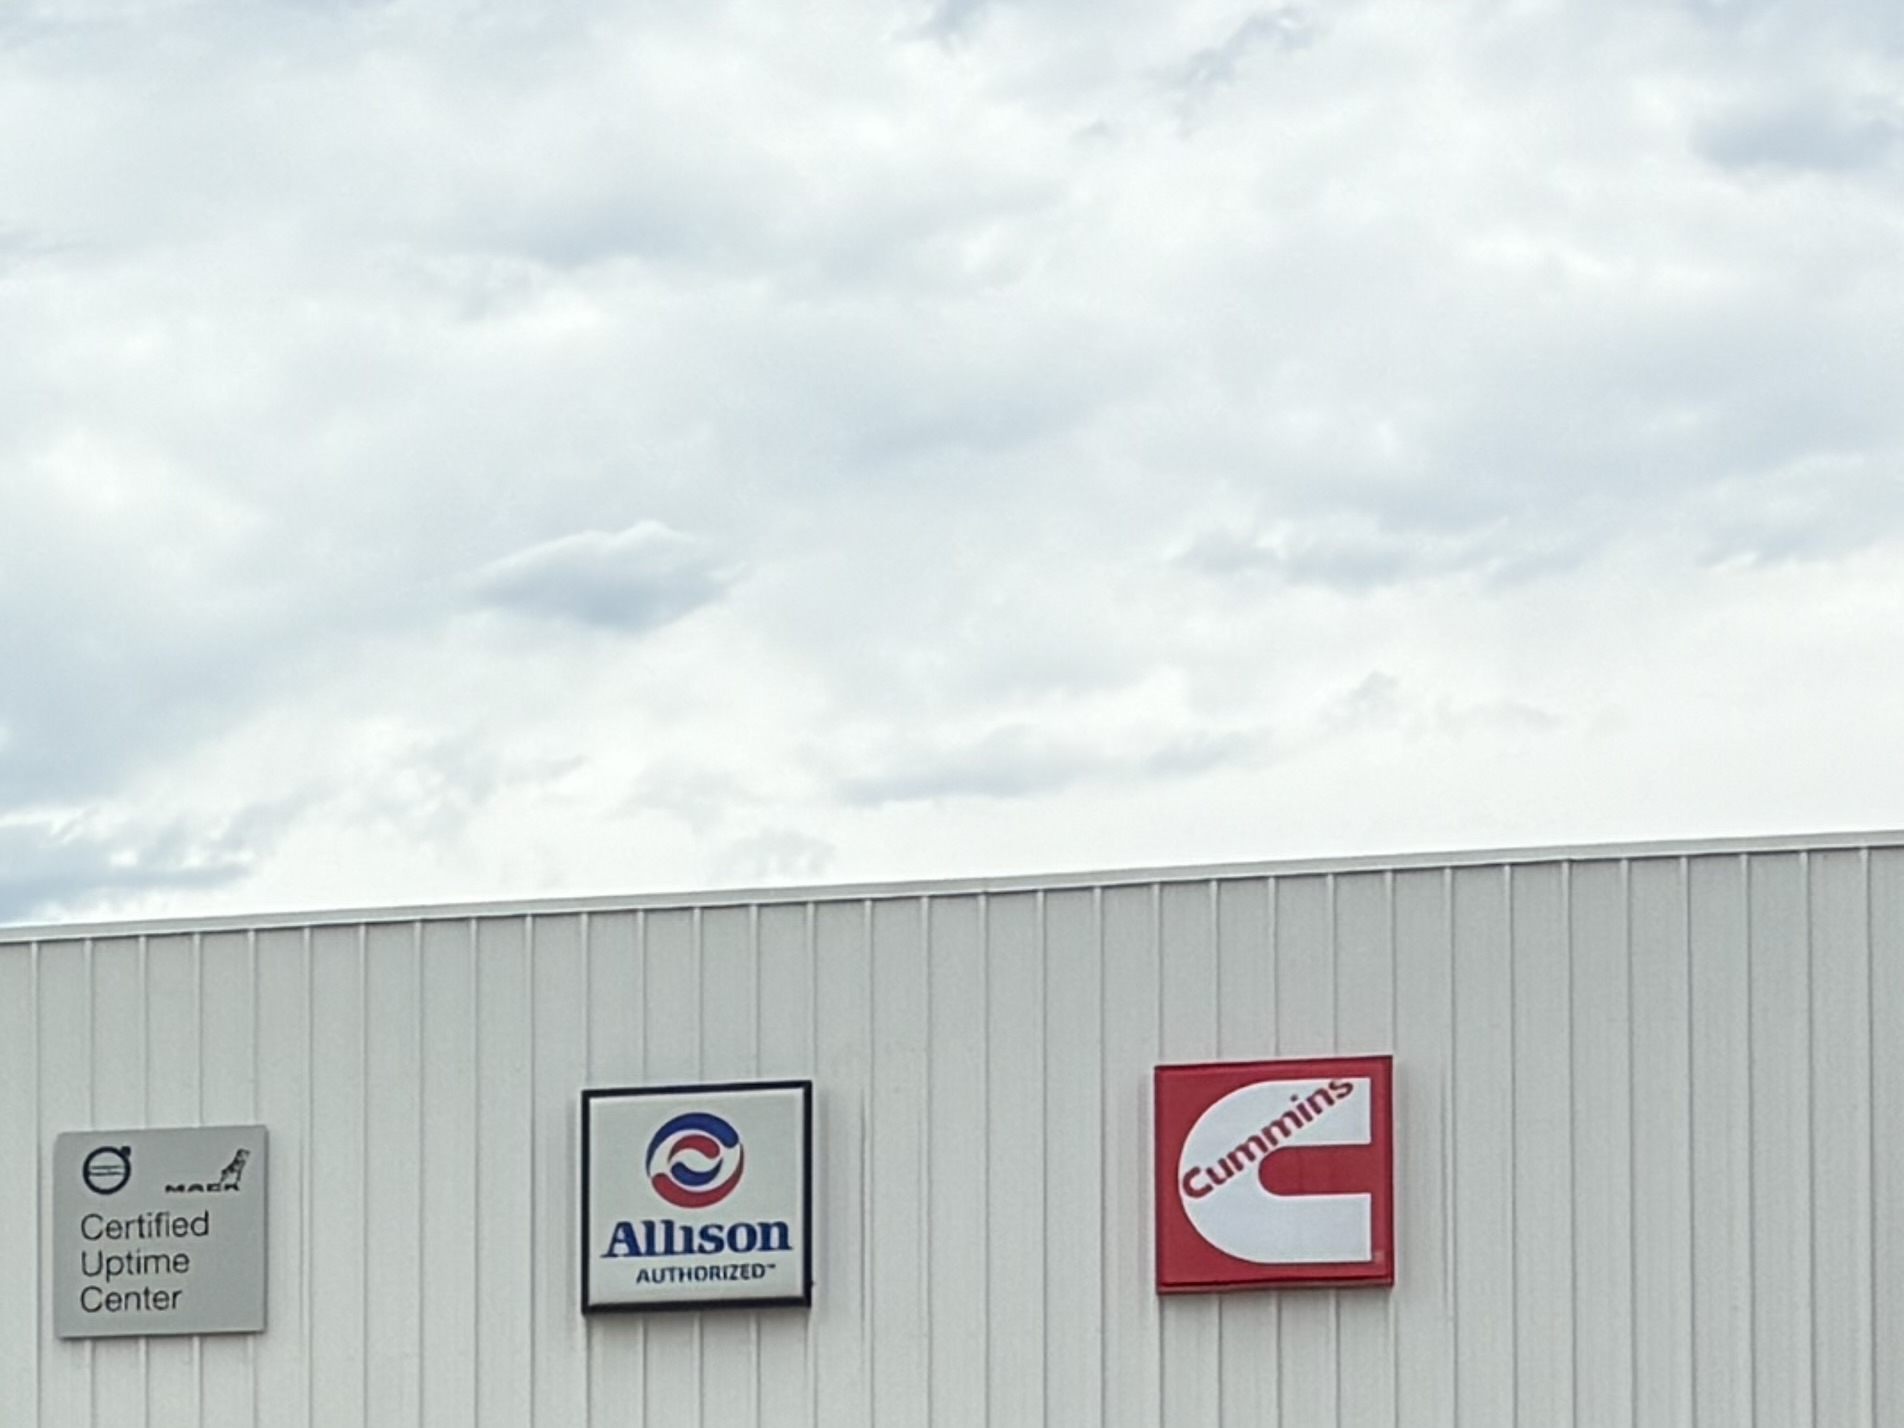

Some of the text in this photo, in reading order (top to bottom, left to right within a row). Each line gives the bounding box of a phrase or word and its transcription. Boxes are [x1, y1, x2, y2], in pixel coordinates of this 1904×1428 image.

[1182, 1080, 1354, 1198] Cummins
[164, 1182, 240, 1193] MACK
[80, 1209, 210, 1241] Certified
[600, 1219, 794, 1258] Allison
[81, 1248, 191, 1283] Uptime
[80, 1286, 183, 1314] Center
